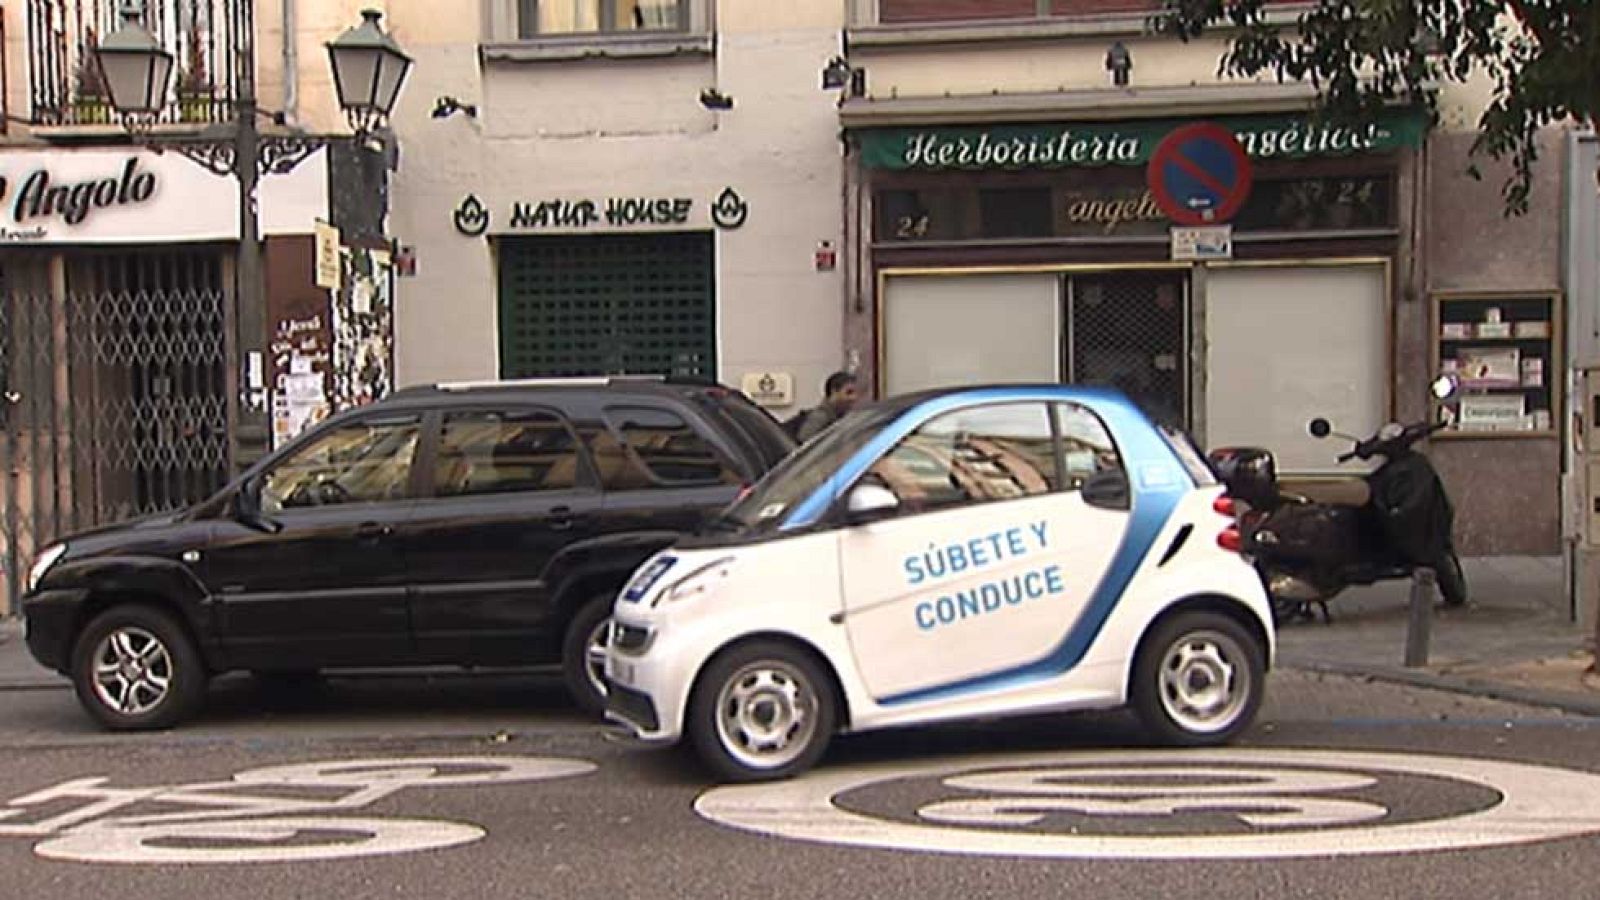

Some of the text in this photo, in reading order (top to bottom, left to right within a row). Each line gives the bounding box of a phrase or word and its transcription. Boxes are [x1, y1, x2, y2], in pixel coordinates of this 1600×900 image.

[1233, 121, 1378, 157] ngélica
[13, 156, 156, 225] Angolo
[510, 196, 693, 228] NATUR HOUSE
[896, 215, 930, 238] 24
[903, 520, 1048, 585] SÚBETE Y
[914, 564, 1065, 631] CONDUCE
